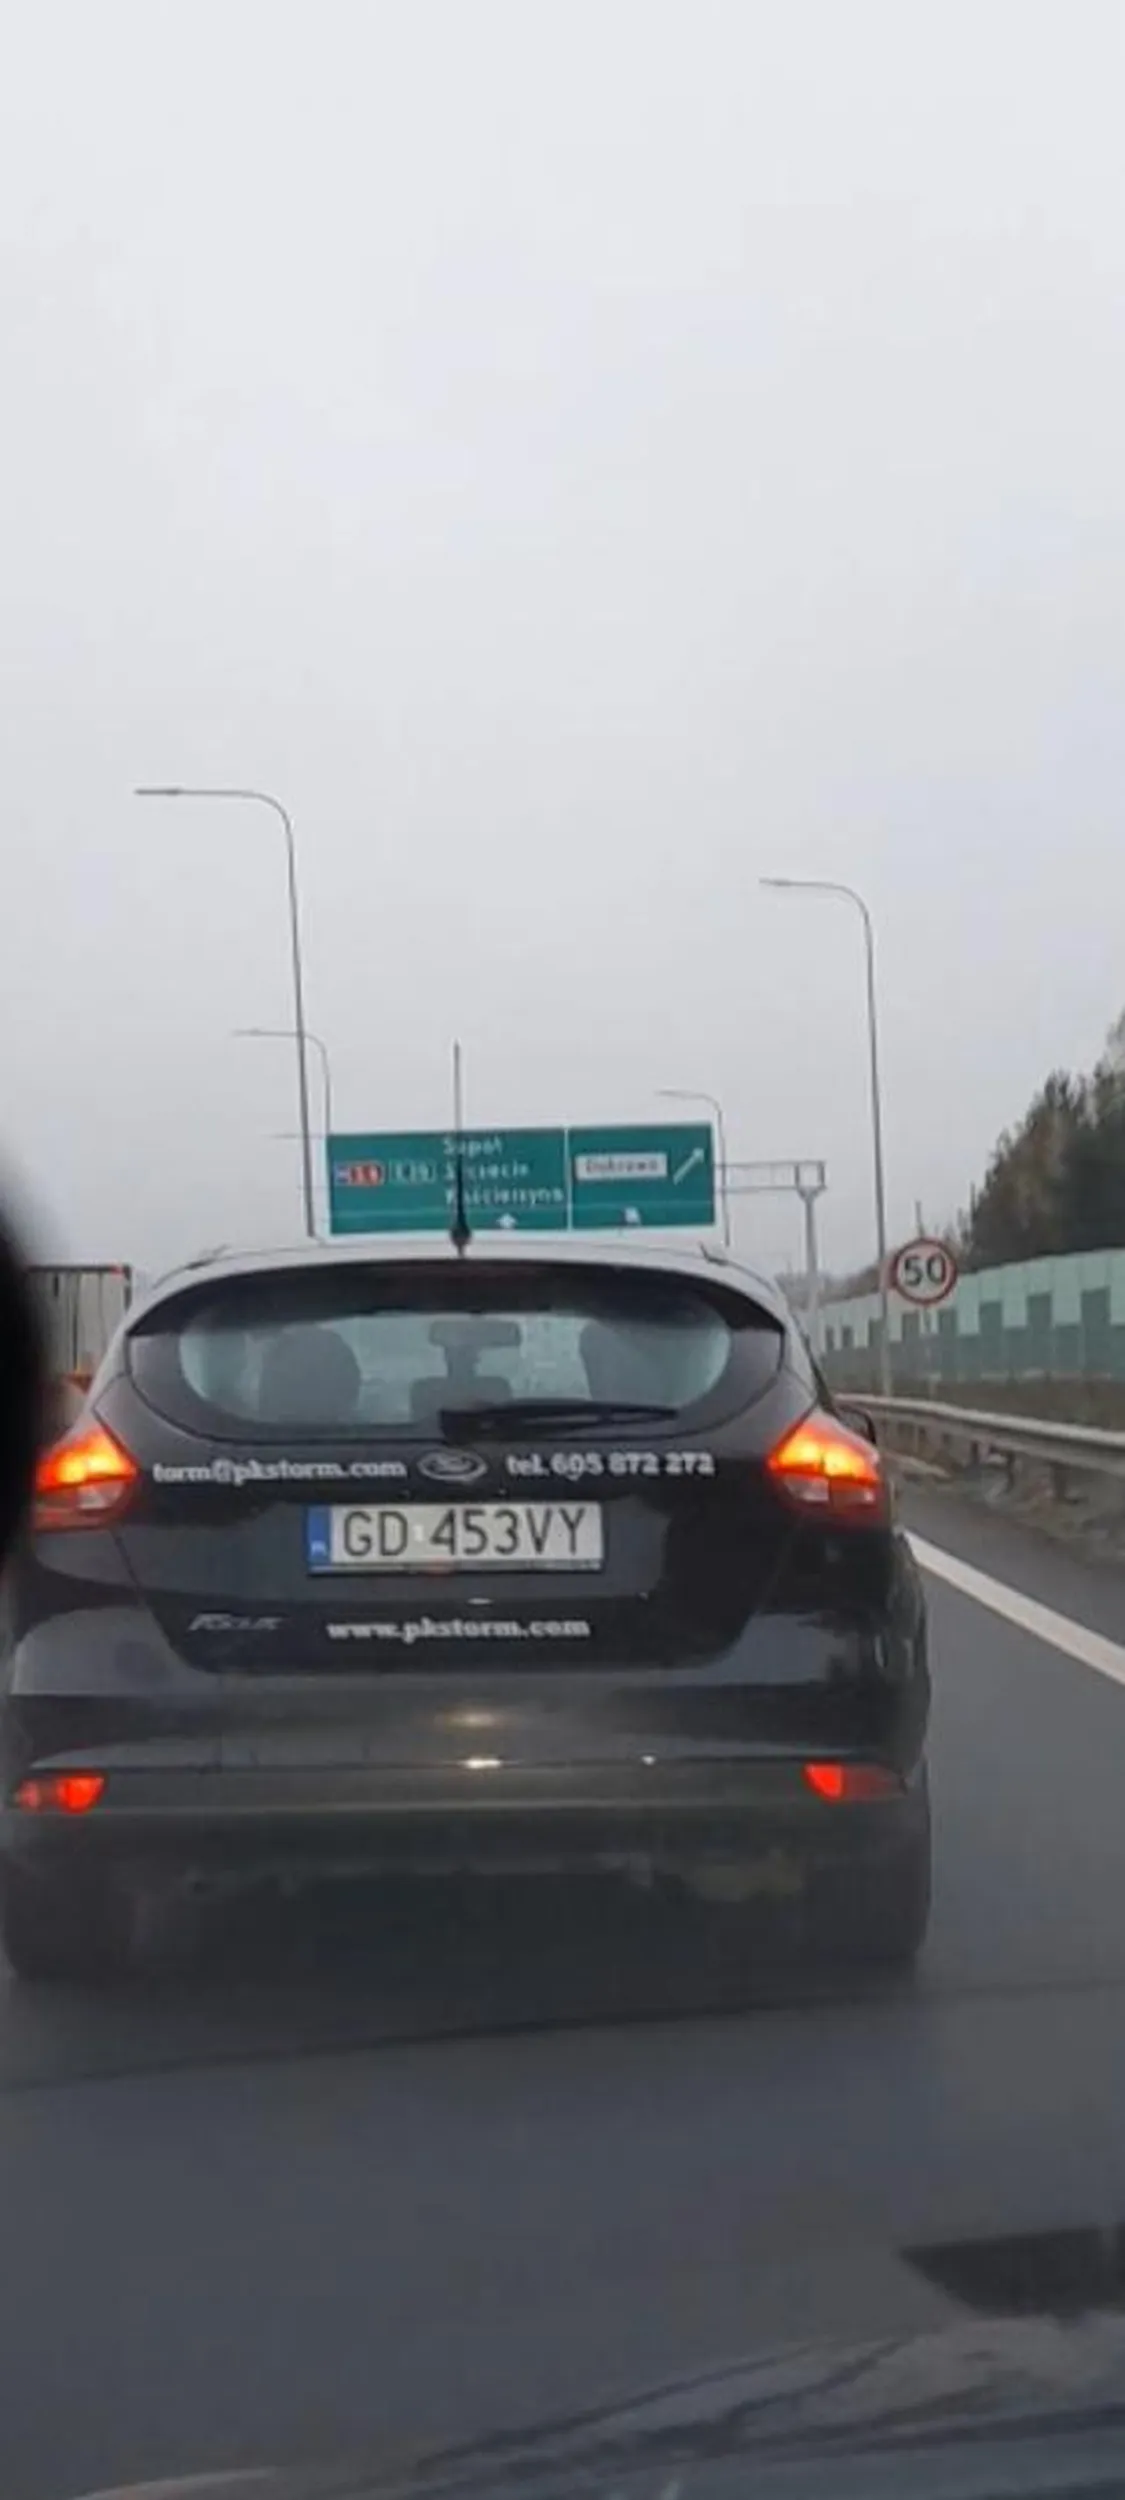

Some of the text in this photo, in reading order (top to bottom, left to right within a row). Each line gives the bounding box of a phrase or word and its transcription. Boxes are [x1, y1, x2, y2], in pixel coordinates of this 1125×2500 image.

[444, 1160, 530, 1179] Sczecin
[904, 1253, 946, 1287] 50
[608, 1452, 660, 1475] 872
[665, 1452, 715, 1475] 272
[344, 1508, 586, 1557] GD 453VY
[326, 1616, 591, 1645] www.pkstorm.com
